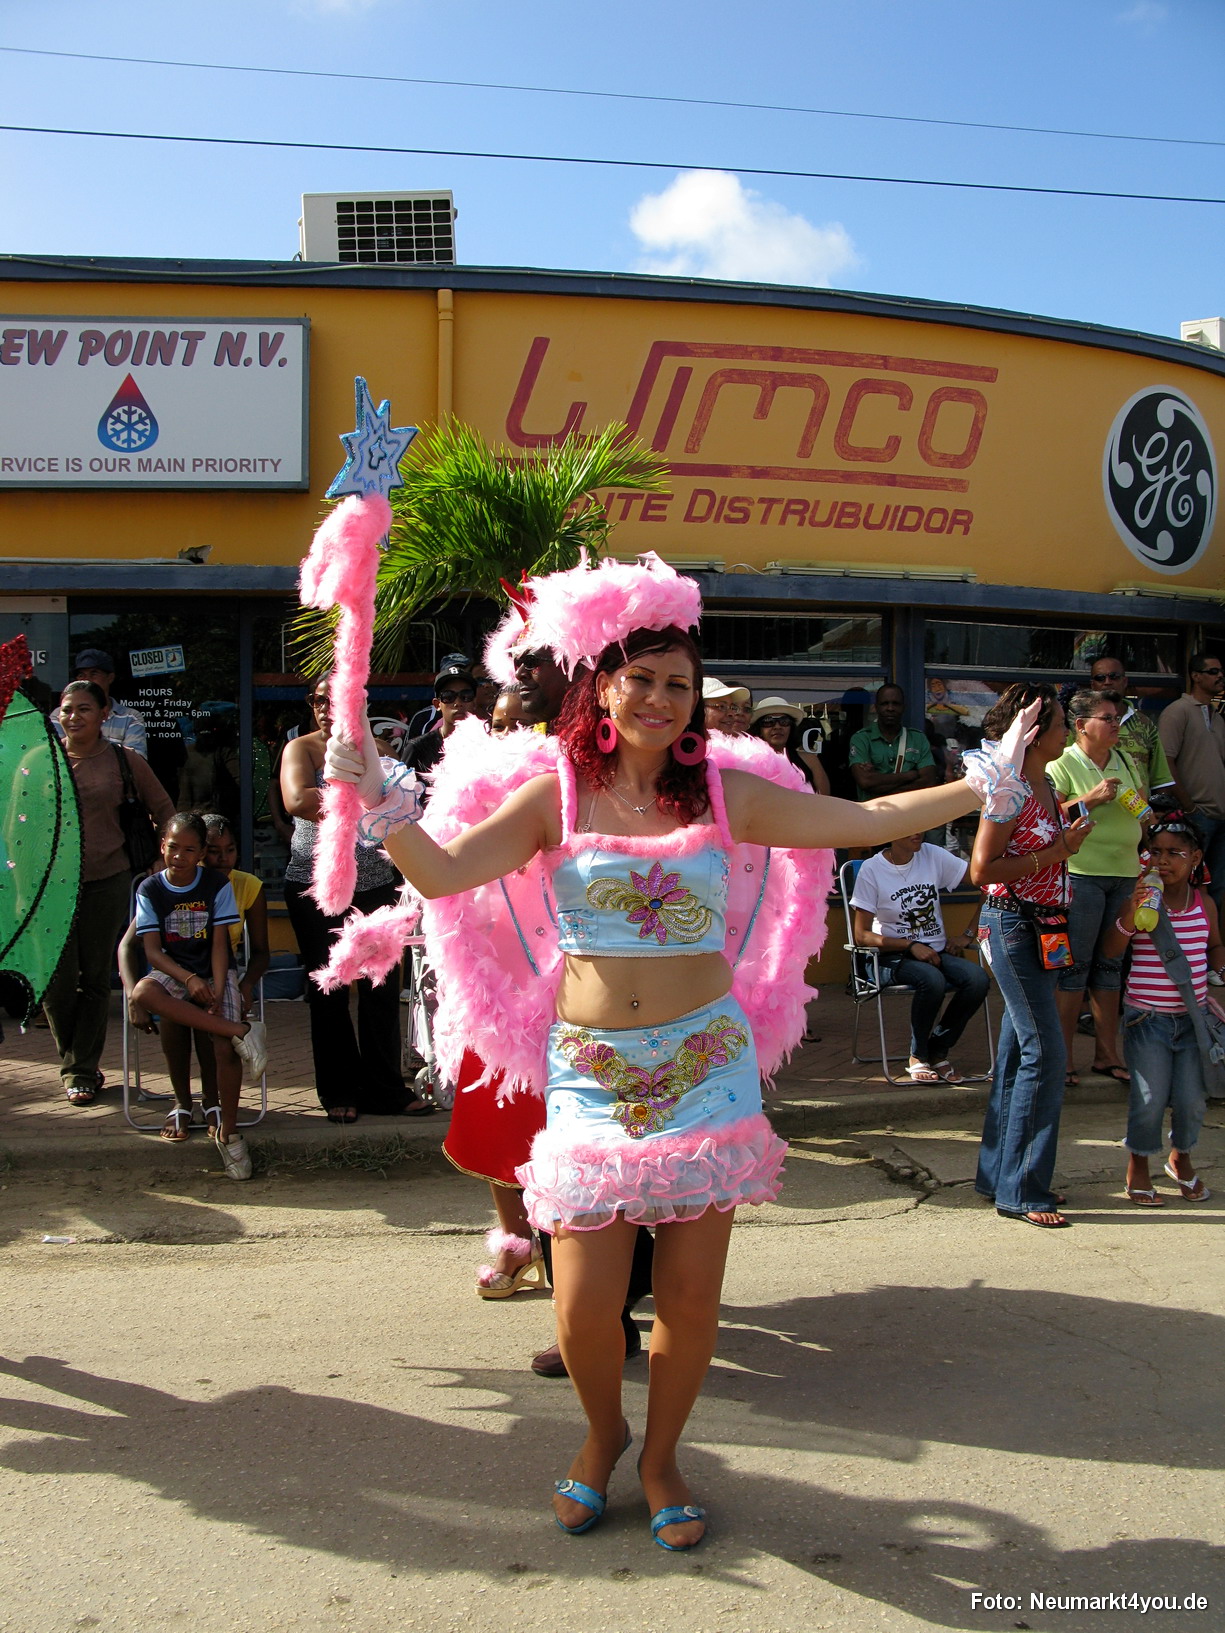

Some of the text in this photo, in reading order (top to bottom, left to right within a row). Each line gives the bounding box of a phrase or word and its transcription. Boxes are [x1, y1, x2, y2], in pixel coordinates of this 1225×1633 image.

[78, 330, 206, 367] POINT
[213, 331, 288, 367] N.V.
[65, 457, 82, 473] IS
[89, 457, 131, 473] OUR
[137, 457, 185, 473] MAIN
[192, 457, 282, 473] PRIORITY
[1132, 431, 1194, 528] GE
[131, 651, 164, 666] CLOSED
[138, 688, 173, 696] HOURS
[120, 699, 155, 708] Monday
[163, 699, 192, 708] Friday
[154, 709, 161, 717] &
[163, 709, 183, 718] 2pm
[191, 709, 211, 718] 6pm
[143, 720, 177, 729] aturday
[802, 728, 823, 753] G
